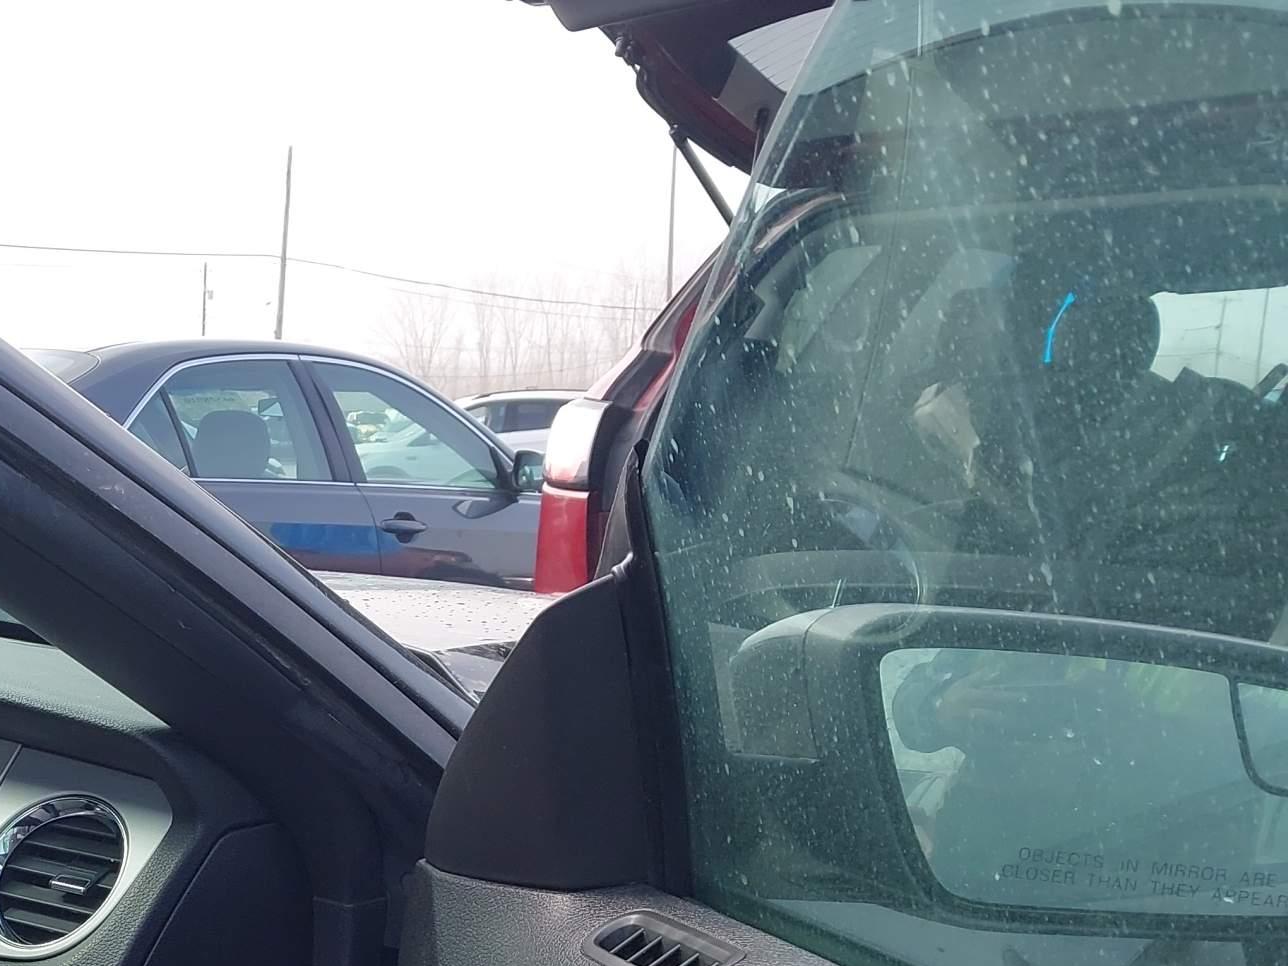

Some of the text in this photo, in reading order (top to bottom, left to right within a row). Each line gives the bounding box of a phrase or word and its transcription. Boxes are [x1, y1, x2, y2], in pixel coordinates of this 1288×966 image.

[1002, 863, 1076, 884] CLOSER
[1088, 874, 1138, 892] THAN
[1151, 880, 1200, 898] THEY
[1019, 847, 1277, 887] OBJECTS IN MIRROR ARE
